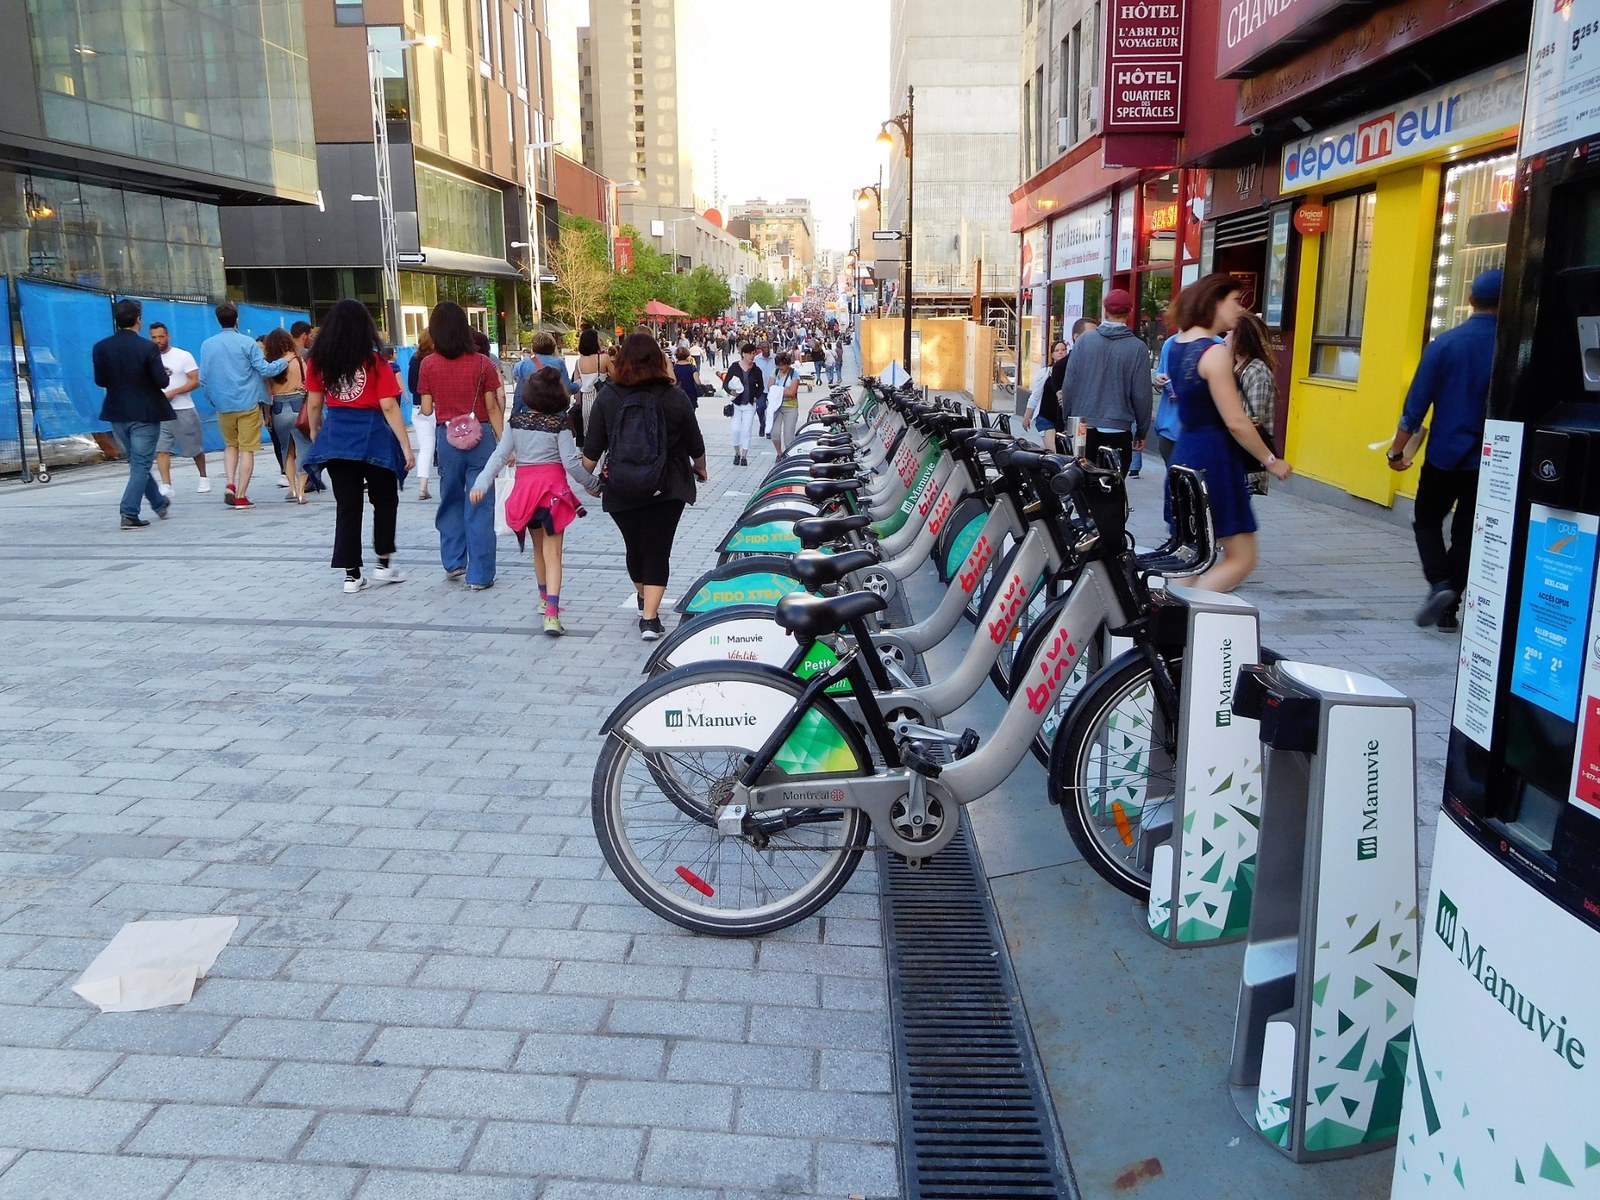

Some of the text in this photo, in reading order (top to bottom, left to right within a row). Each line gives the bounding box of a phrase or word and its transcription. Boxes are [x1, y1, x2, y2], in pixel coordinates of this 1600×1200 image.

[1120, 1, 1179, 19] HÔTEL
[1119, 26, 1179, 37] L'ABRI DU
[1227, 0, 1297, 48] CHAM
[1119, 37, 1179, 48] VOYAGEUR
[1118, 67, 1177, 85] HÔTEL
[1122, 90, 1171, 102] QUARTIER
[1116, 106, 1175, 118] SPECTACLES
[1284, 94, 1461, 182] dépanneur
[1152, 209, 1166, 231] SEX
[909, 461, 936, 502] Manuvie
[918, 478, 940, 518] bixi
[928, 492, 953, 536] bixi
[1557, 523, 1577, 536] OPUS
[745, 535, 769, 544] FIDO
[959, 535, 993, 594] bixi
[713, 589, 782, 602] FIDO XTRA
[1537, 591, 1570, 608] ACCÈS OPUS
[987, 574, 1028, 646] bixi
[727, 634, 763, 644] Manuvie
[804, 659, 831, 671] Petit
[1026, 628, 1077, 715] bixi
[1220, 637, 1233, 706] Manuvie
[687, 710, 758, 729] Manuvie
[1362, 738, 1380, 830] Manuvie
[782, 789, 830, 802] Montréal
[1457, 926, 1586, 1070] Manuvie
